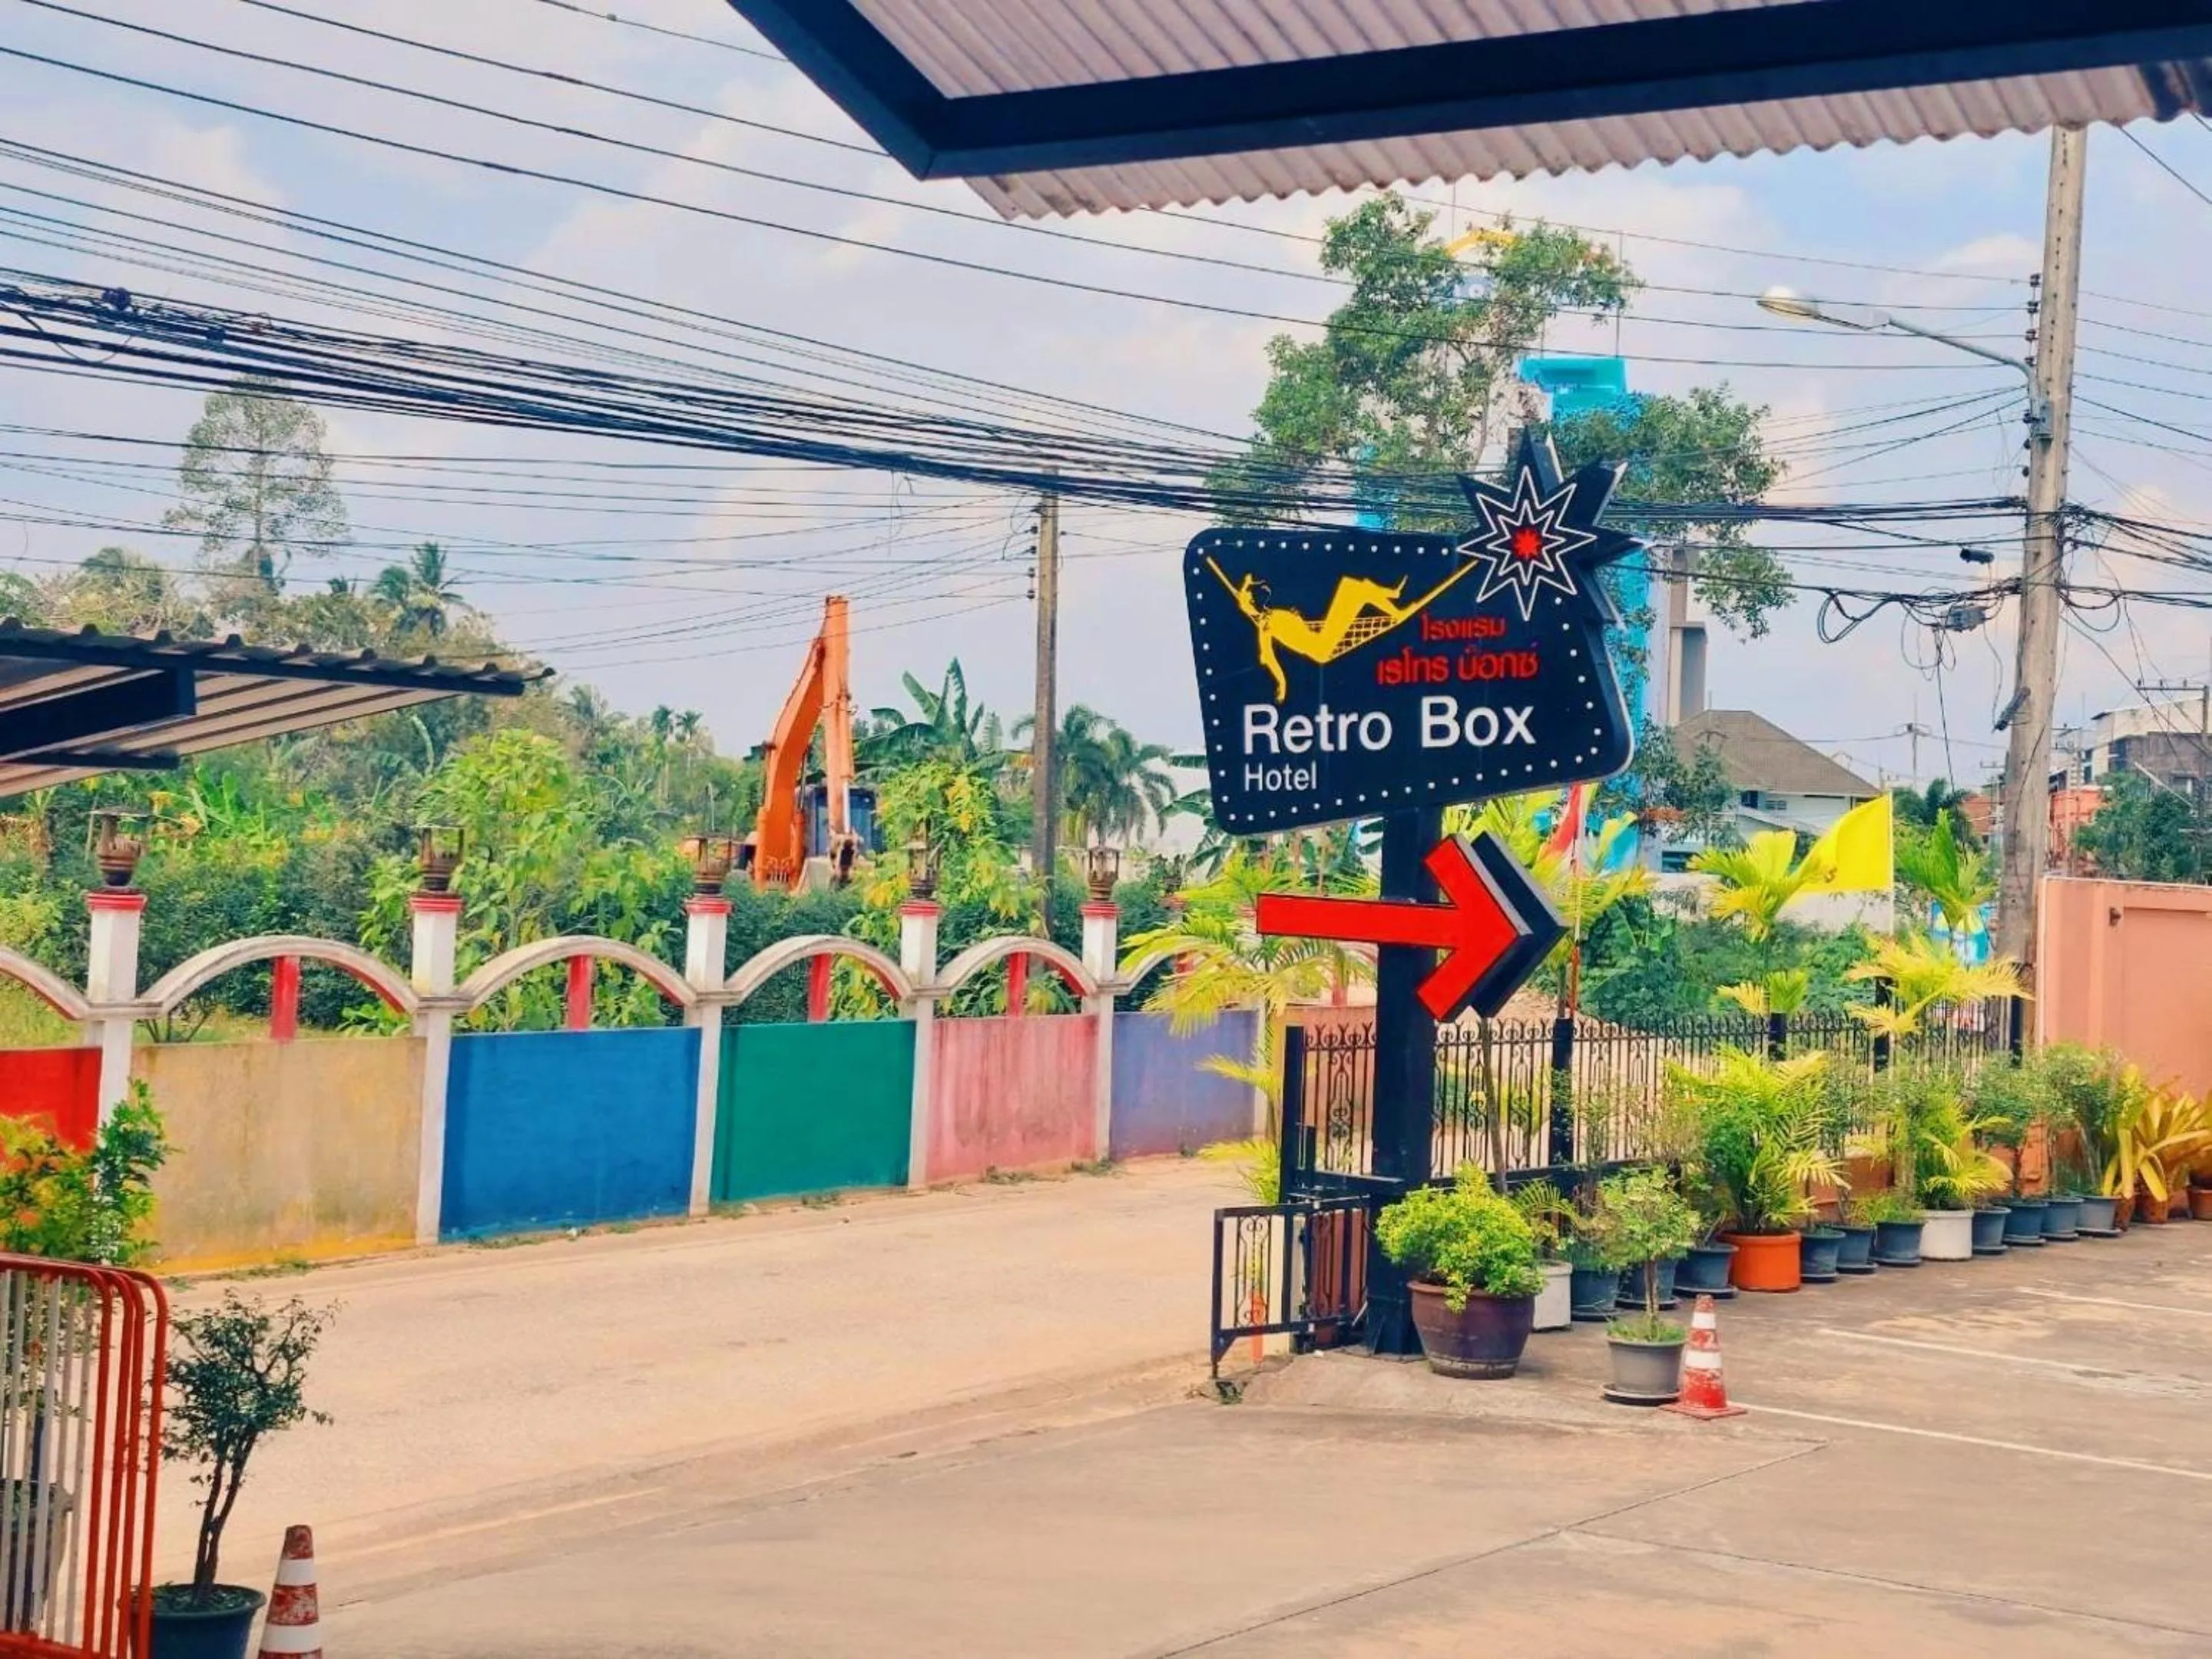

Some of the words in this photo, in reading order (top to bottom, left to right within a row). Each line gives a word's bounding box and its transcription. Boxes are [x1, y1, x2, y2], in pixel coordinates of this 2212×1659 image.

[1422, 612, 1506, 641] โรงแรม
[1243, 703, 1392, 754] Retro
[1421, 695, 1536, 748] Box
[1244, 760, 1318, 791] Hotel
